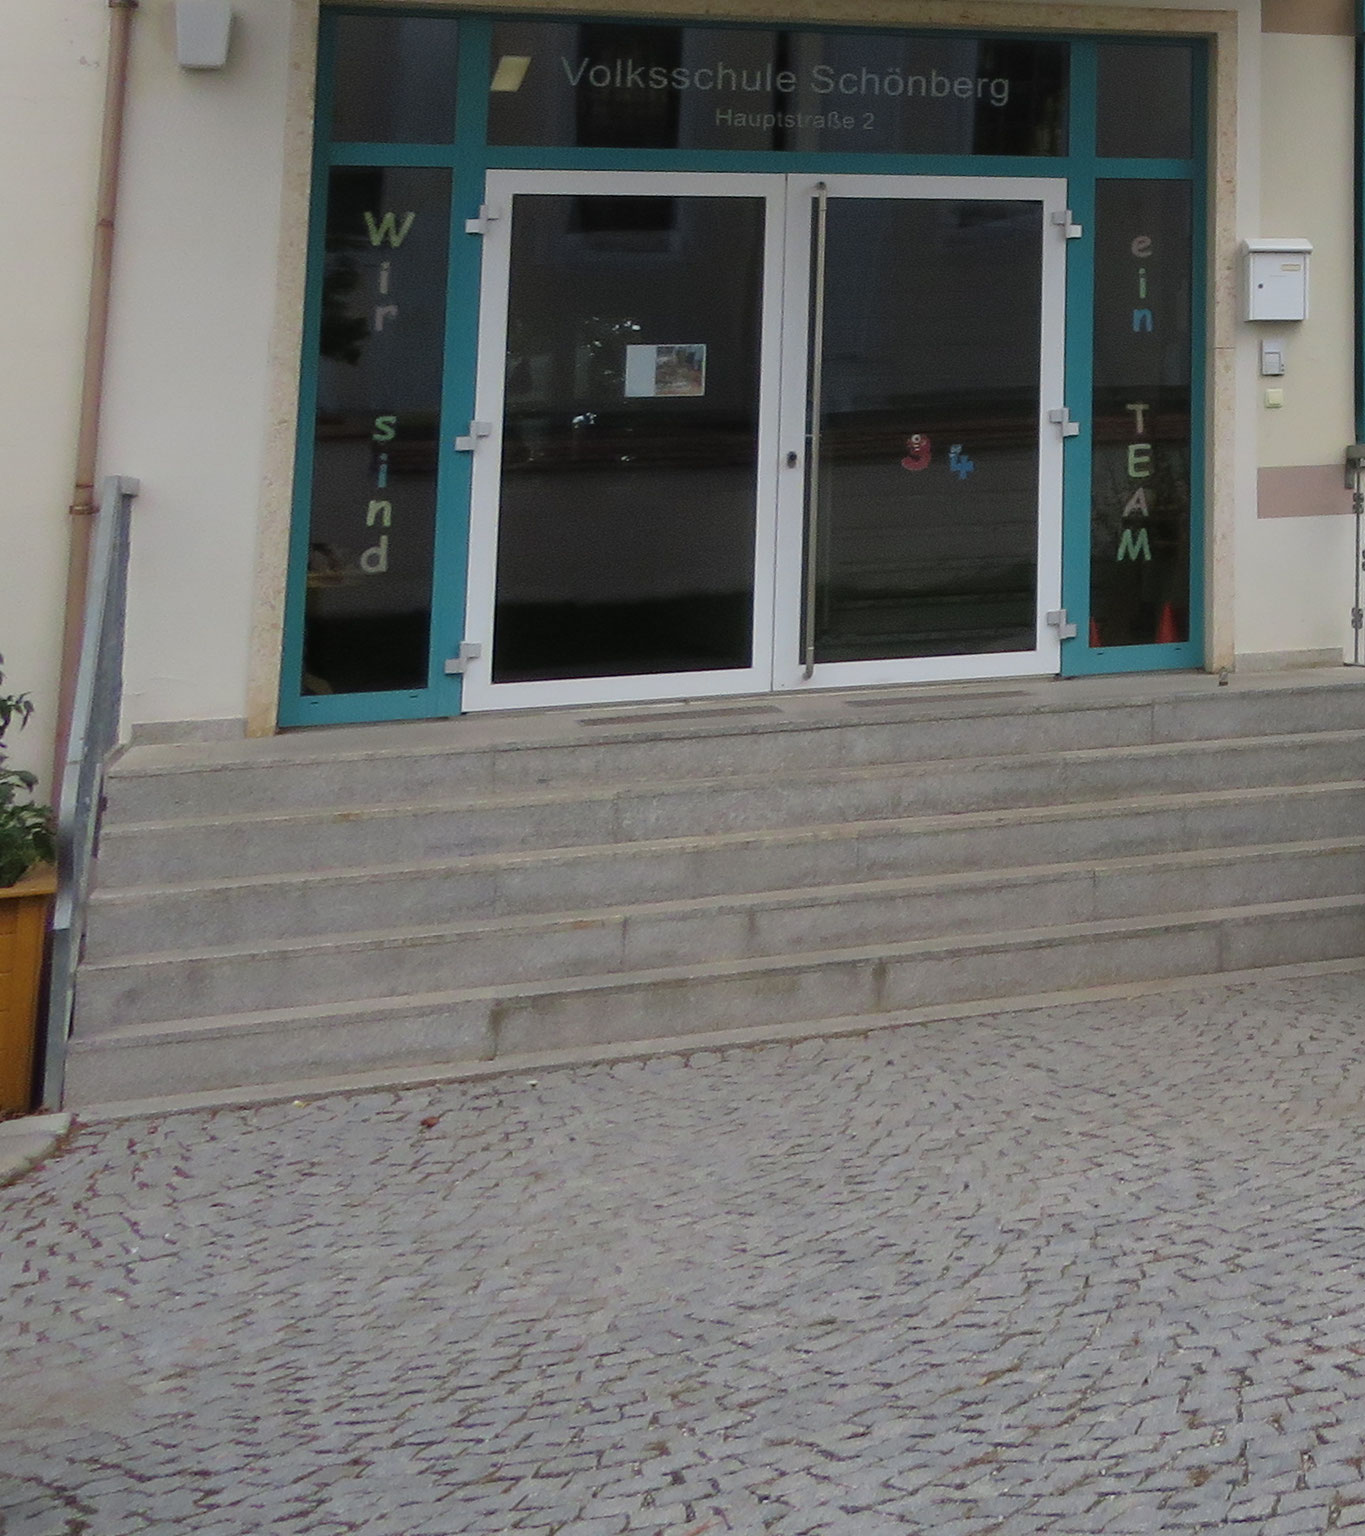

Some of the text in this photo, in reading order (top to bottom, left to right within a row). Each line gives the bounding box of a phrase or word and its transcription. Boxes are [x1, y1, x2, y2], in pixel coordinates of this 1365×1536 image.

[561, 56, 1010, 107] Volksschule Schönberg
[714, 107, 875, 132] Hauptstraße 2
[1116, 400, 1153, 562] TEAM
